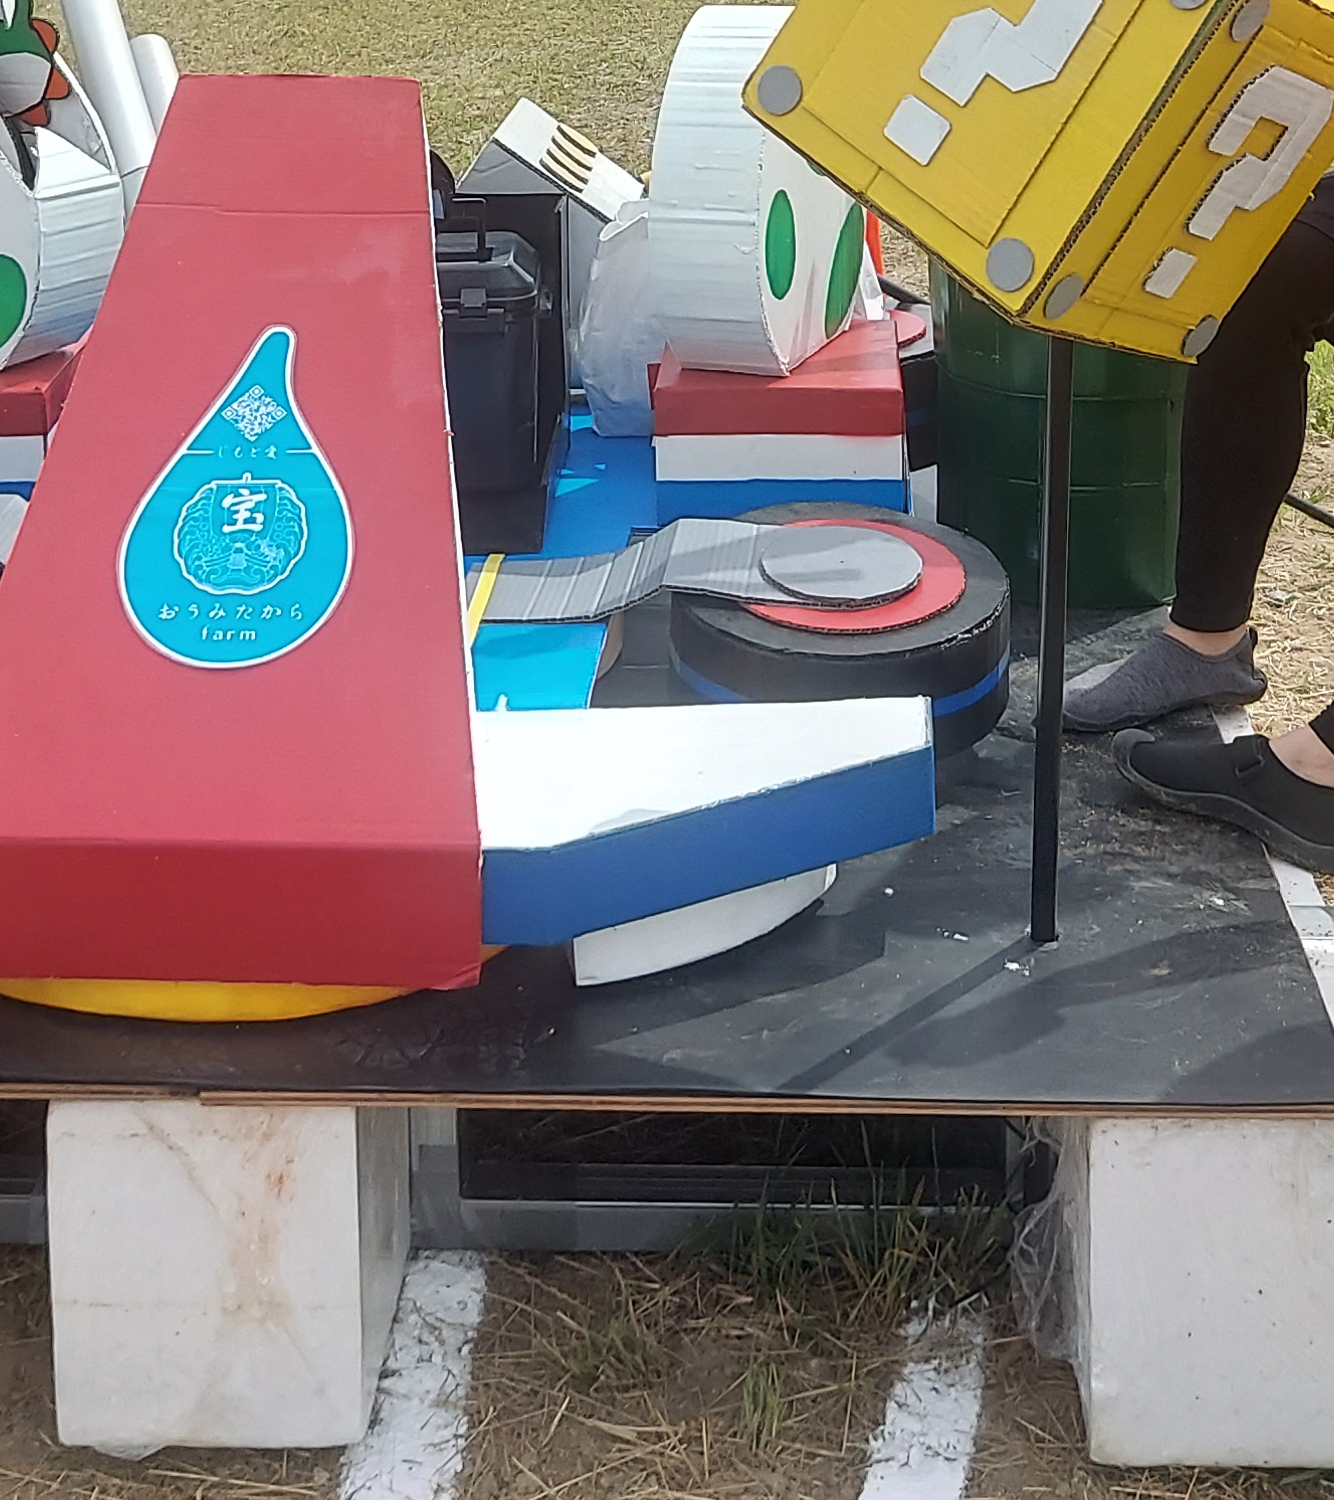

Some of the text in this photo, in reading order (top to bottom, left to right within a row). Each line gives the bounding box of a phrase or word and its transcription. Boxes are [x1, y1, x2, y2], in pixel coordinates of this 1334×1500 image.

[221, 488, 267, 533] 宝
[158, 603, 303, 620] おうみたから
[201, 624, 257, 641] farm
